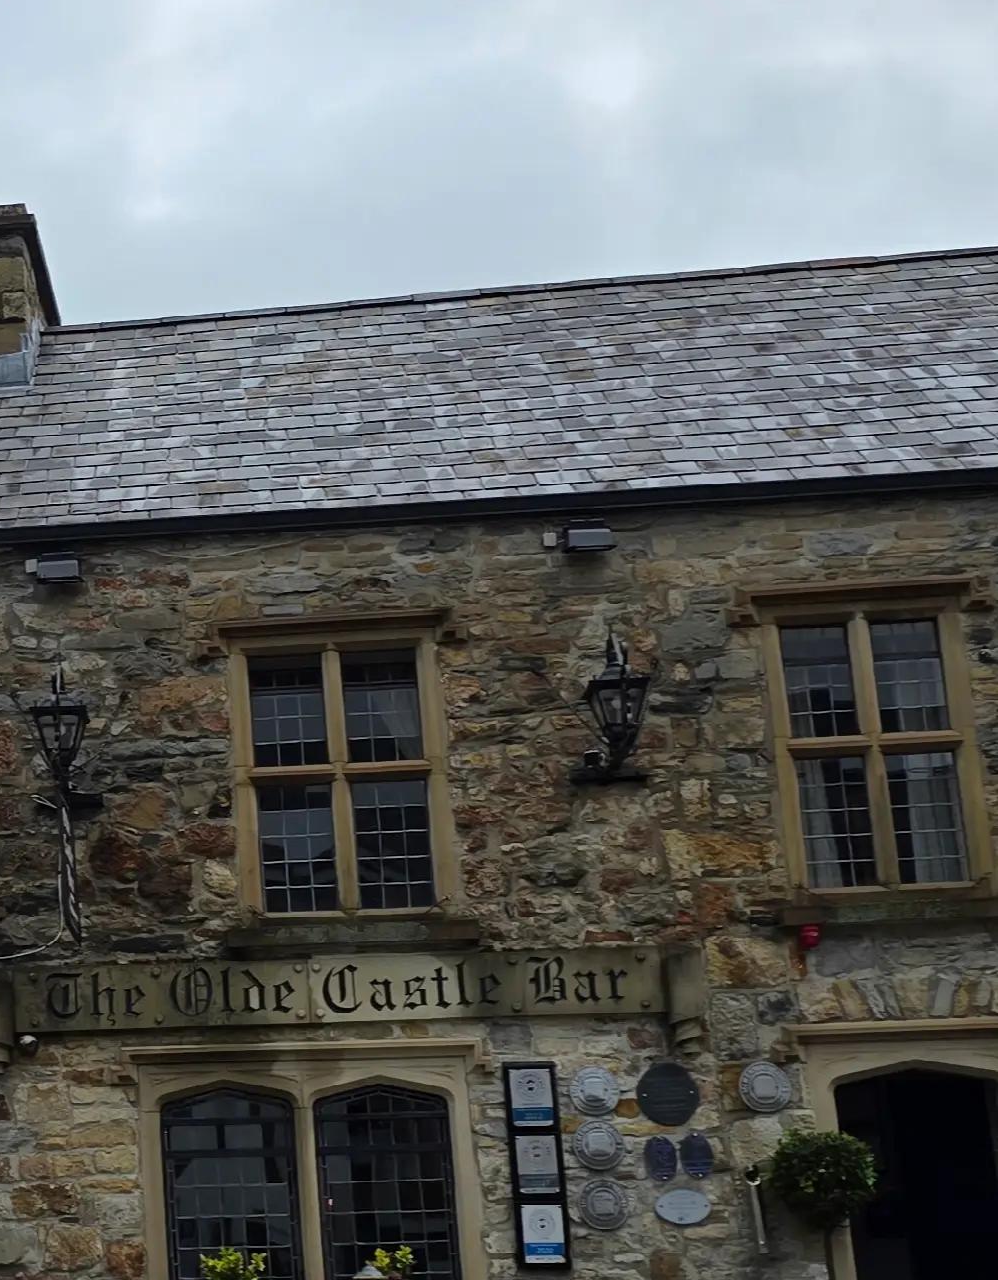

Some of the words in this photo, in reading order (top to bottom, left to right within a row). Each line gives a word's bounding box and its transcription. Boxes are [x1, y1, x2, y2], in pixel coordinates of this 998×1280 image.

[45, 970, 147, 1026] The
[169, 966, 295, 1018] Olde
[322, 959, 502, 1014] Castle
[524, 956, 629, 1005] Bar
